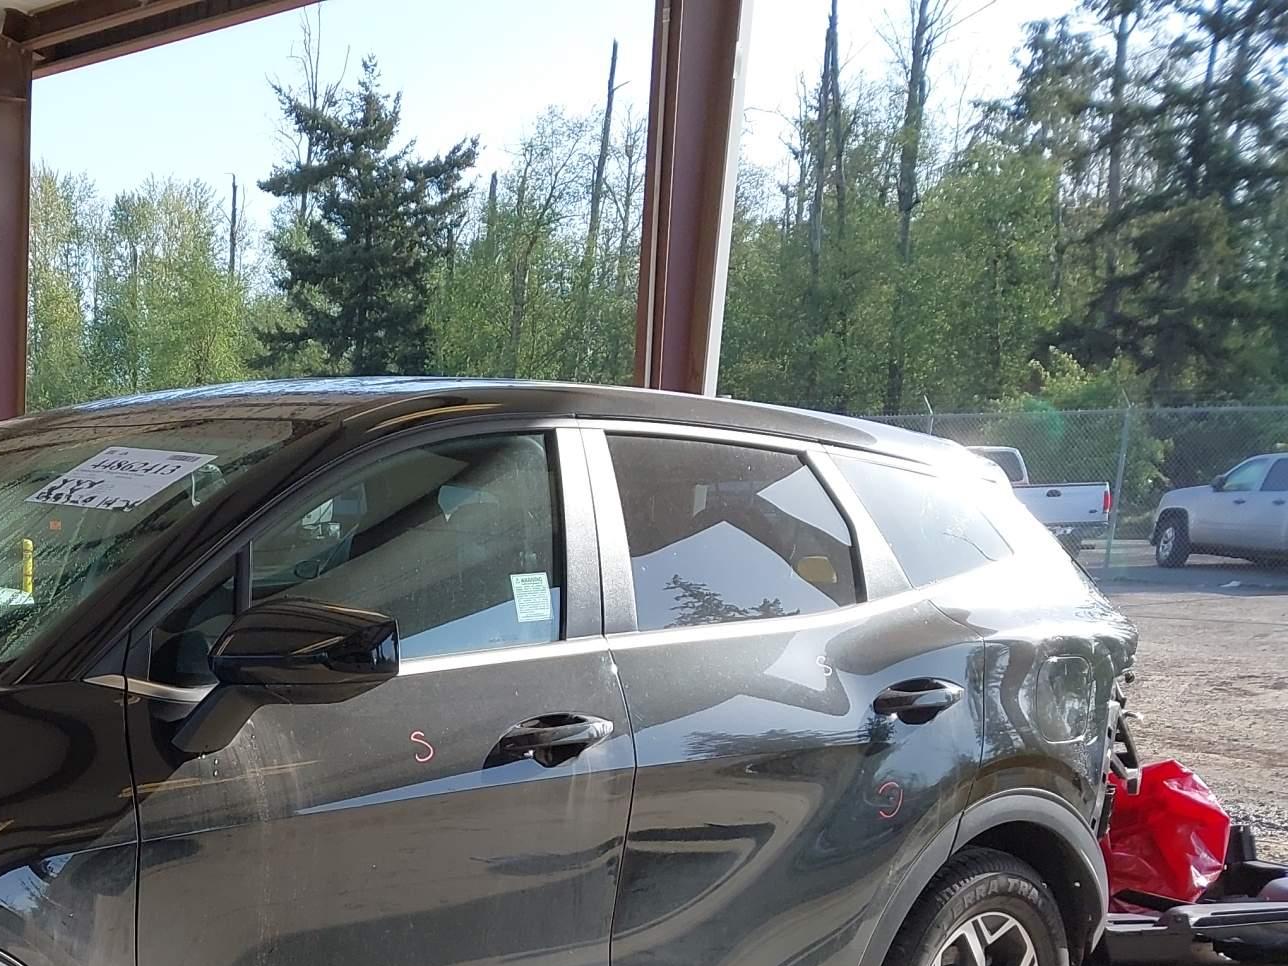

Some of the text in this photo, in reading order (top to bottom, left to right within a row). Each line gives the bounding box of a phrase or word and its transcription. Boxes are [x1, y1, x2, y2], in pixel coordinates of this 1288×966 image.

[90, 458, 182, 476] 44862413
[815, 655, 833, 677] S
[410, 730, 434, 762] S
